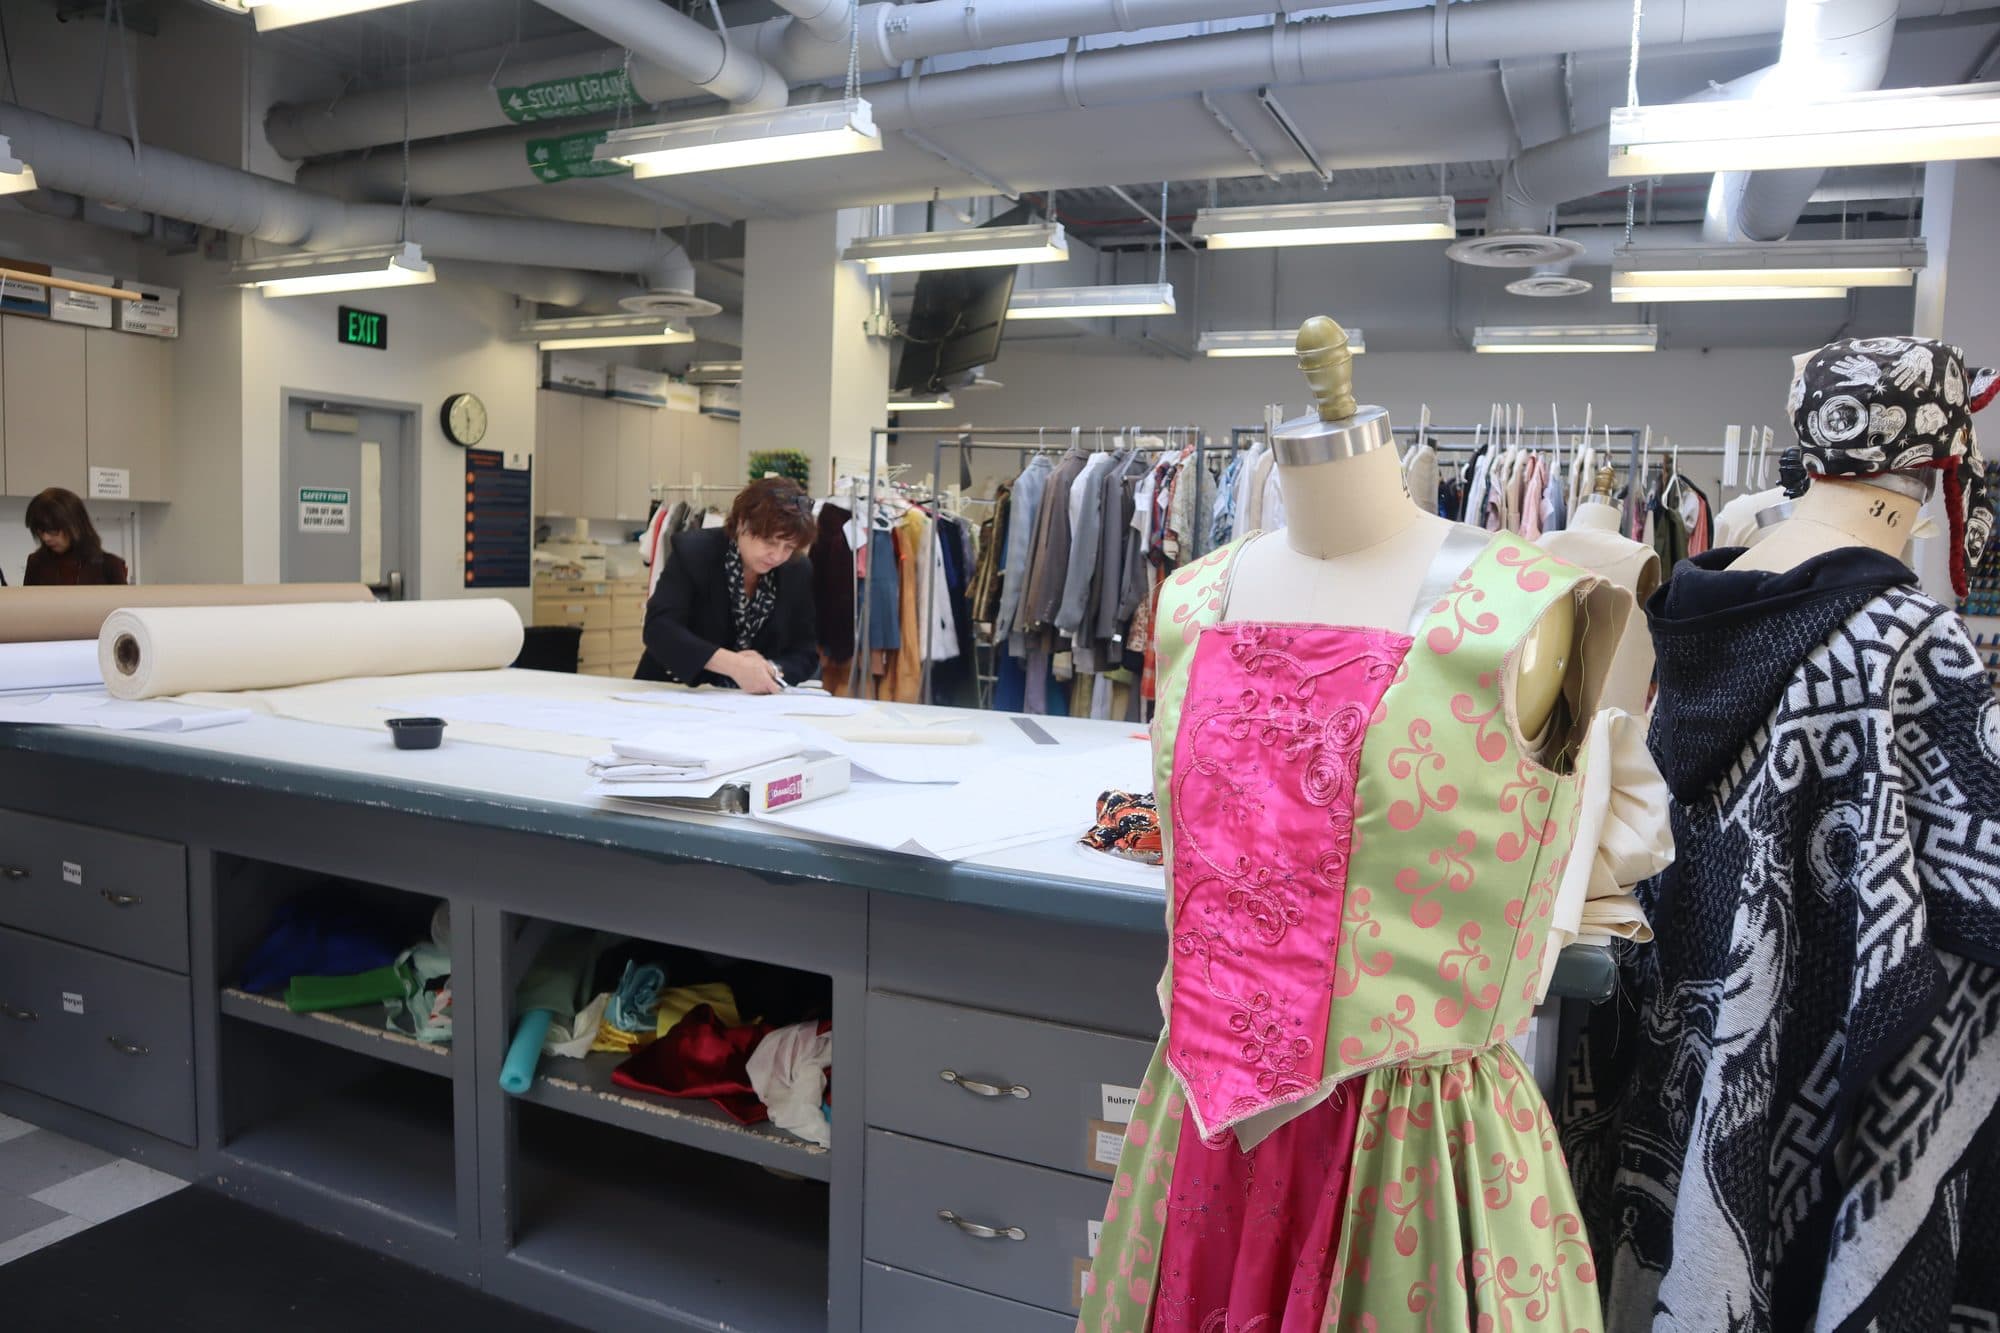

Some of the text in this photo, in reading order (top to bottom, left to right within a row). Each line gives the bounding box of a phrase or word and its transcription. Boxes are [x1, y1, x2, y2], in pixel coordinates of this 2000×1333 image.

[527, 75, 626, 106] STORM DRAIN
[348, 311, 379, 345] EXIT
[302, 491, 347, 502] SAFETY FIRST
[305, 506, 319, 515] TURN
[1869, 499, 1901, 528] 36
[303, 516, 323, 526] BEFORE
